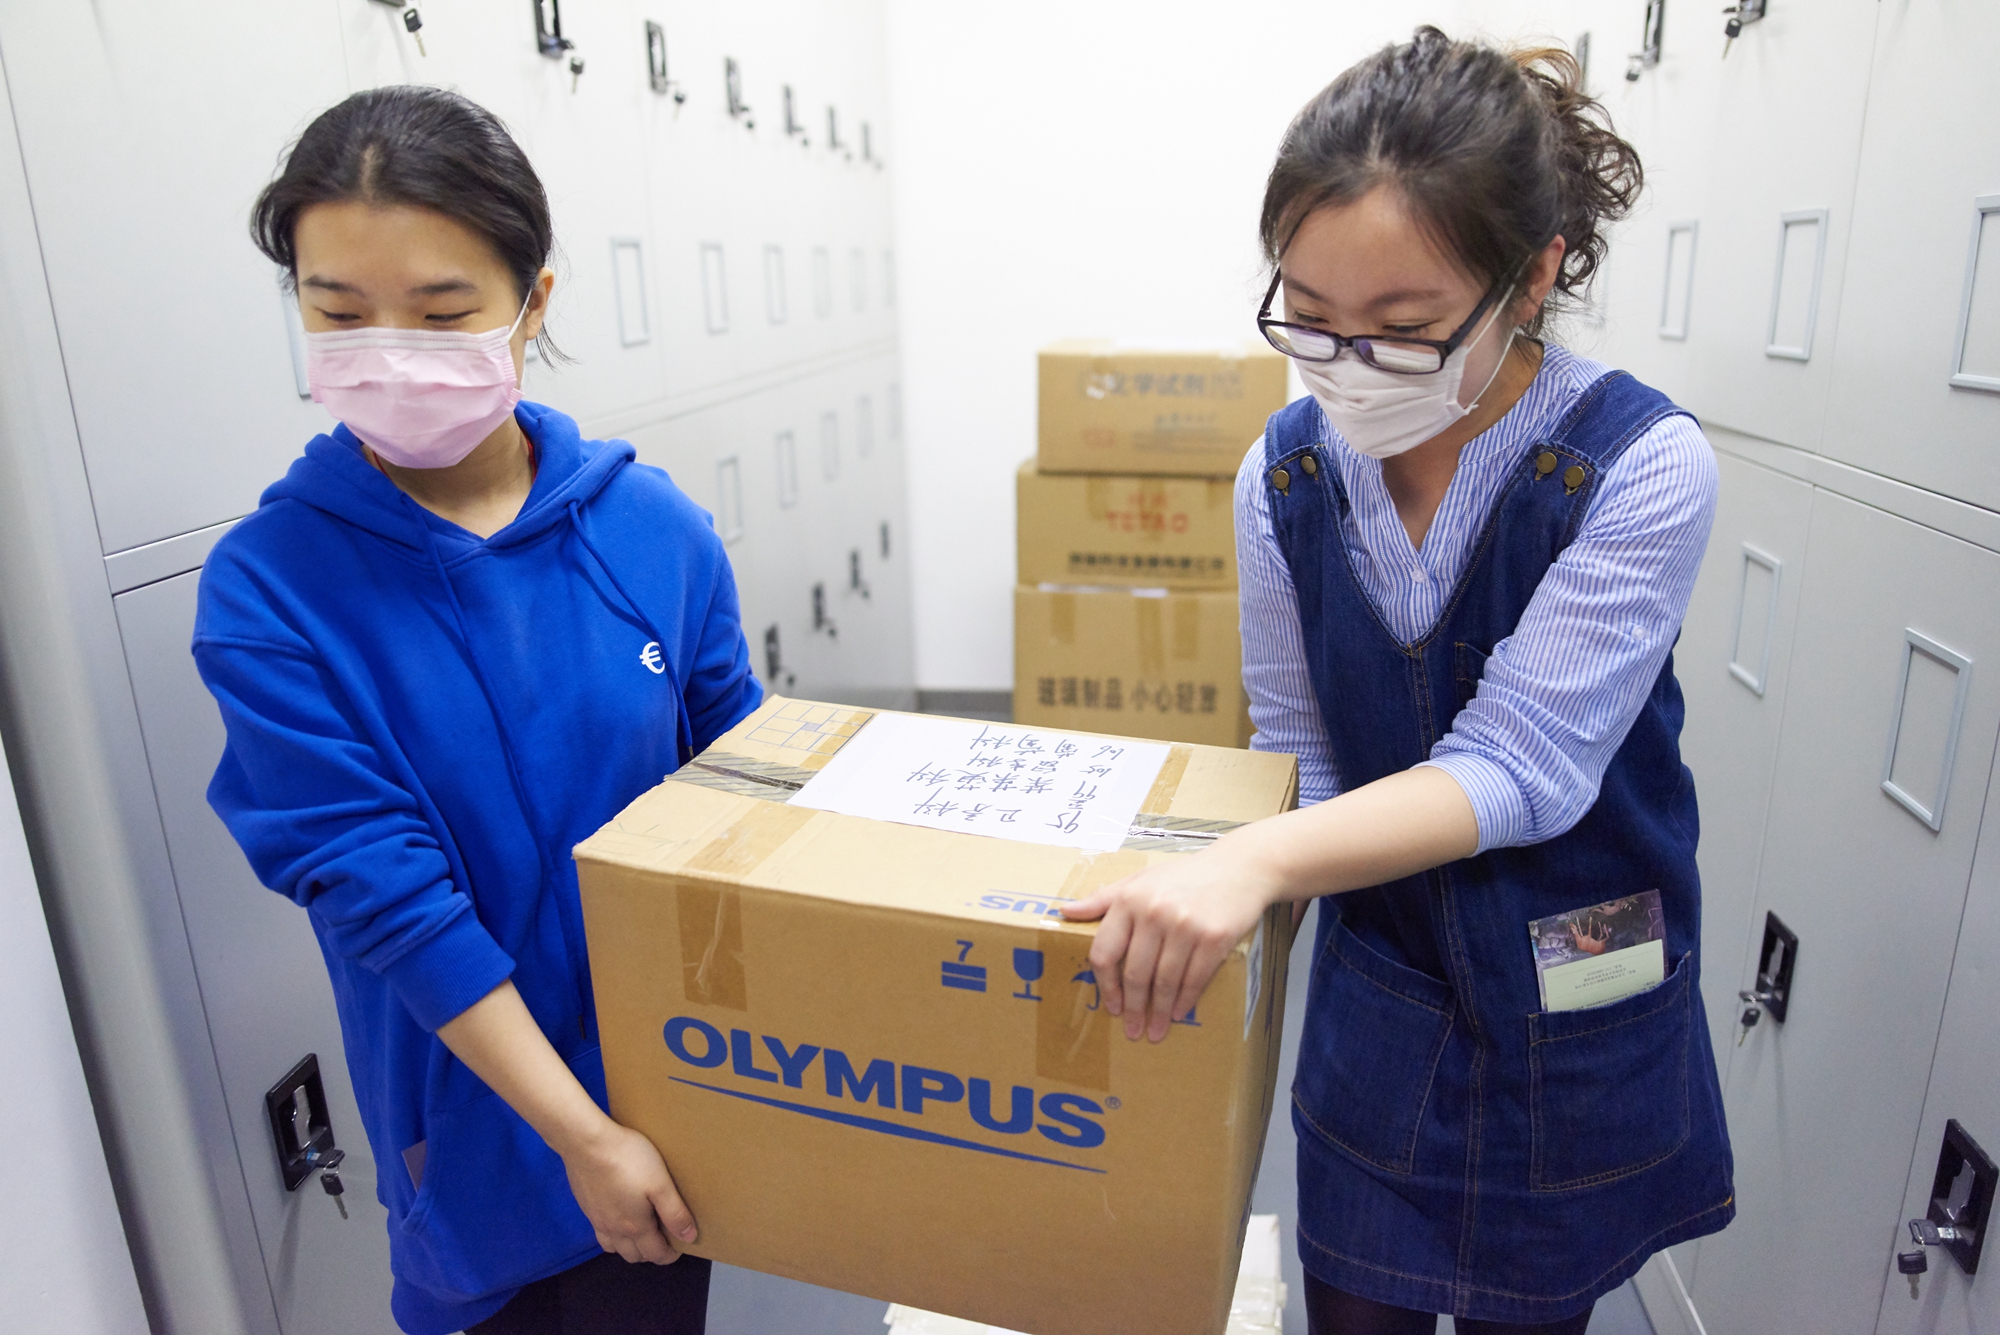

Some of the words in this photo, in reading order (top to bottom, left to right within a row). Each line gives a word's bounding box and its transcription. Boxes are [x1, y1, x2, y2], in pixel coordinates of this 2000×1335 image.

[1073, 780, 1097, 800] 99
[1045, 810, 1082, 833] 95
[663, 1016, 1106, 1148] OLYMPUS
